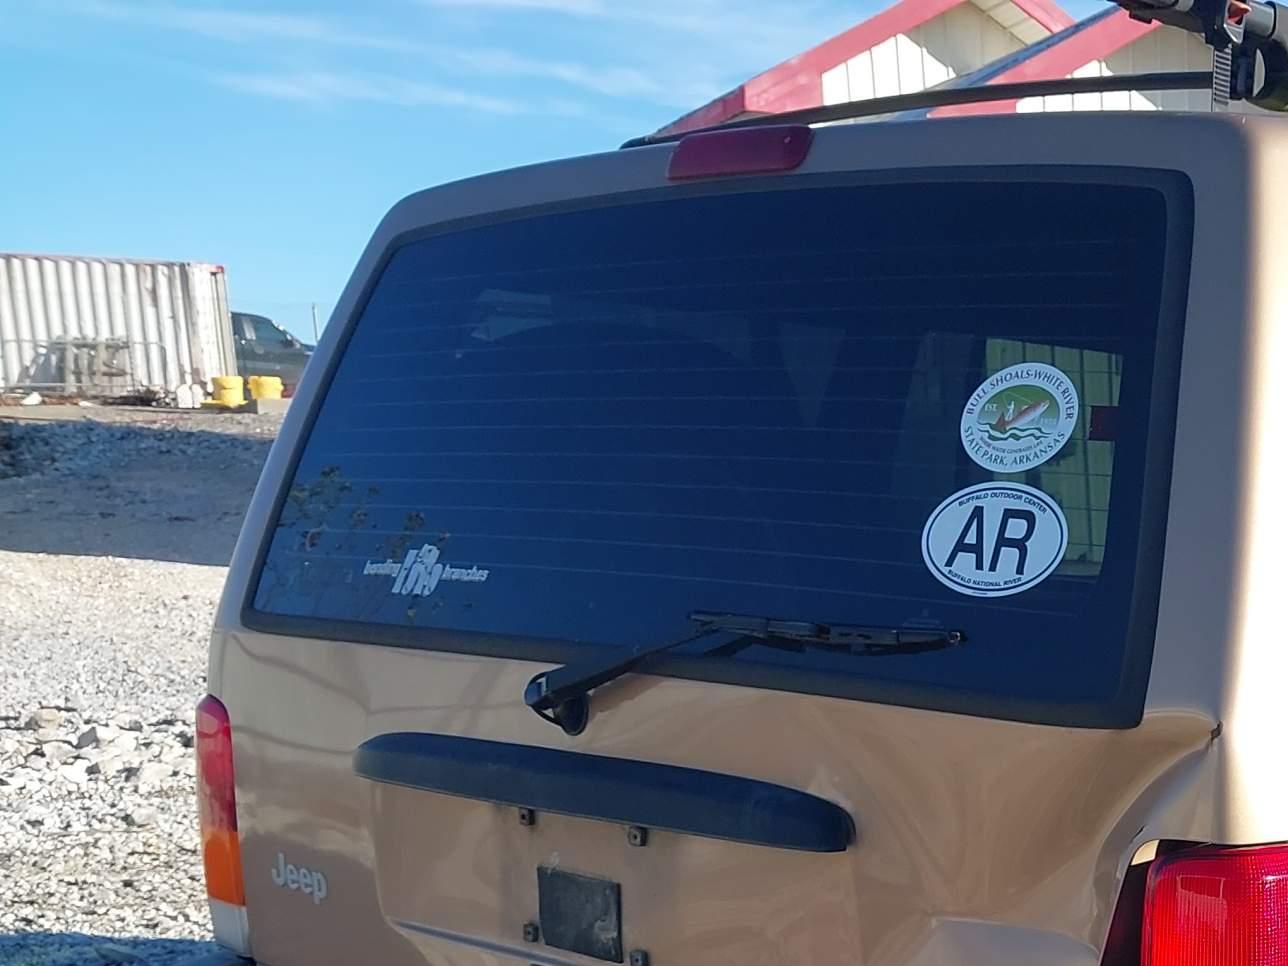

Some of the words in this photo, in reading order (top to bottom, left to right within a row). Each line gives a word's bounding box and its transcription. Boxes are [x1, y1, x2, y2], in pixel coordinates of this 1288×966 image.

[1060, 387, 1075, 420] RIVER
[964, 425, 981, 455] STATE
[1010, 431, 1065, 466] ARKANSAS
[958, 492, 989, 507] BUFFALO
[990, 492, 1023, 502] OUTDOOR
[1023, 497, 1048, 515] CENTER
[944, 505, 1036, 576] AR
[440, 563, 490, 582] branches
[972, 579, 1002, 587] NATIONAL
[1003, 577, 1022, 587] RIVER
[271, 852, 328, 905] Jeep
